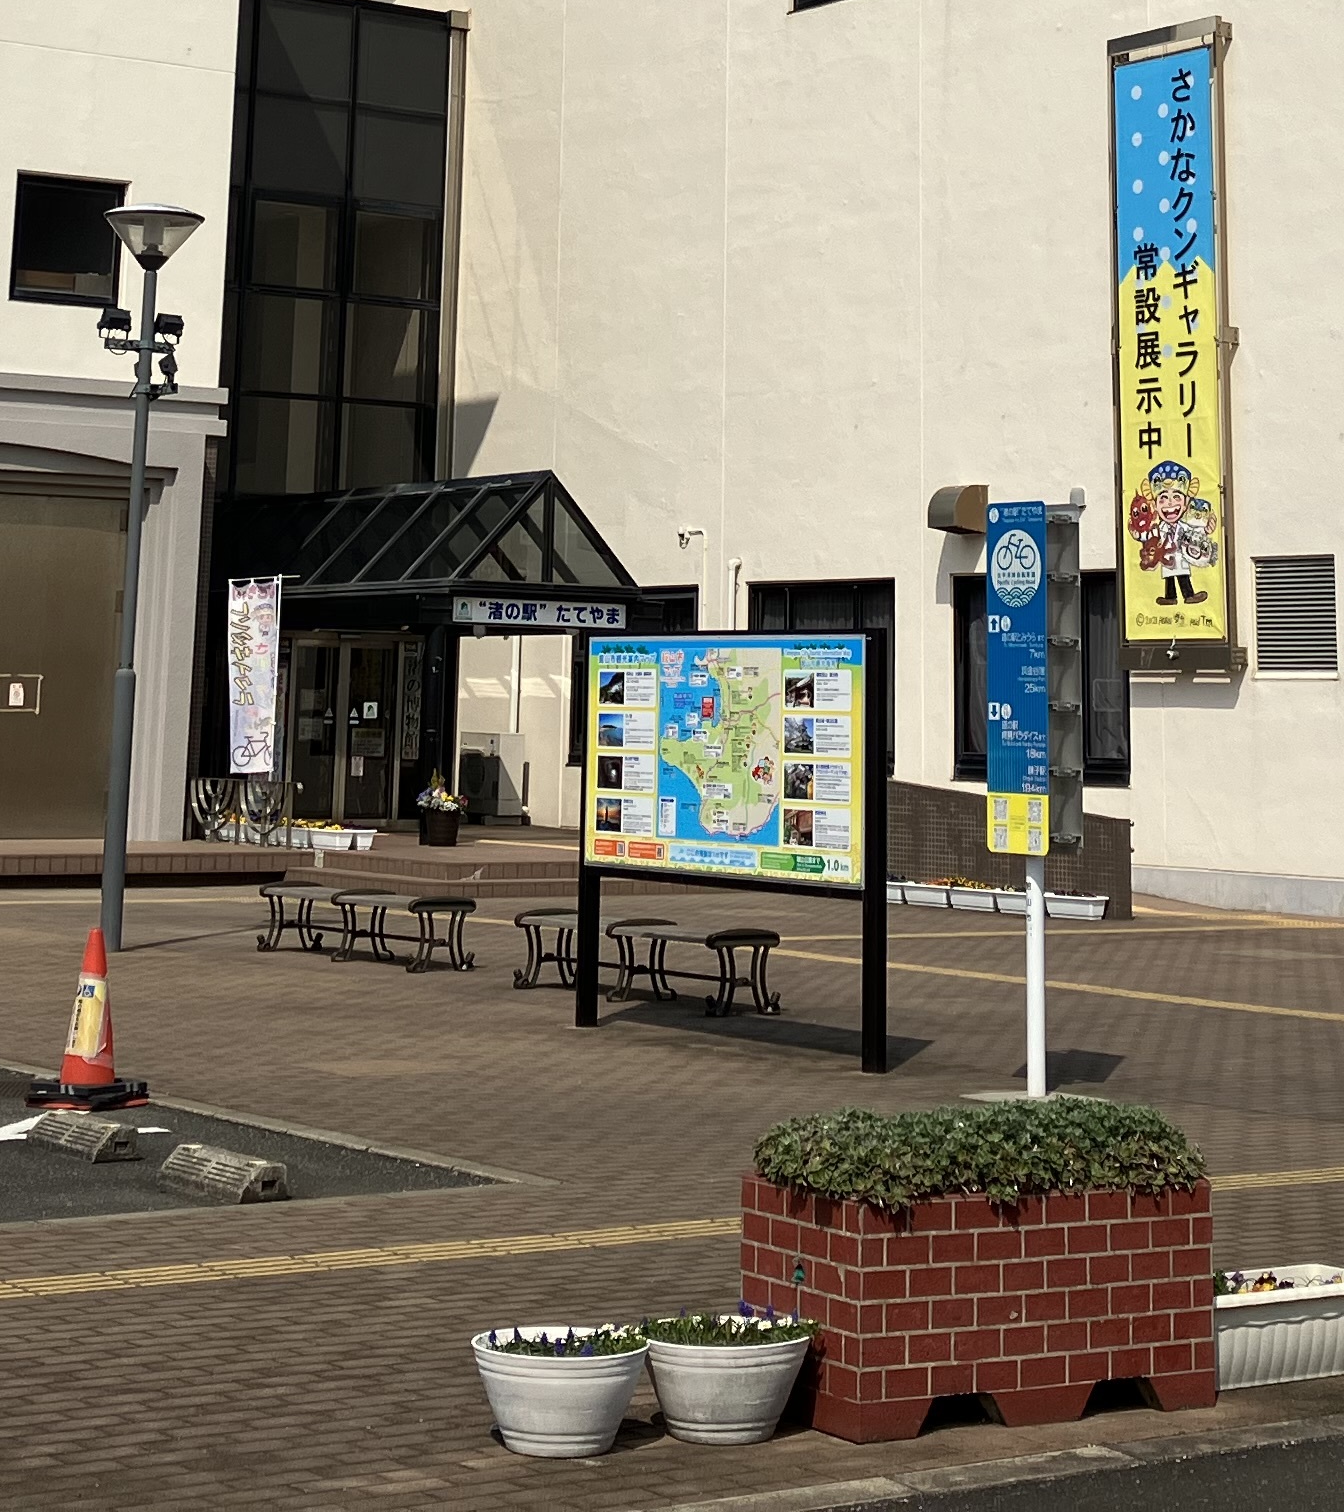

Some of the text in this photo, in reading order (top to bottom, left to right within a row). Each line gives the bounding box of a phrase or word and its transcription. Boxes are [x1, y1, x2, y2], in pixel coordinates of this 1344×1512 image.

[1133, 242, 1163, 460] 常設展示中
[1169, 68, 1199, 458] さかなクンギャラリー
[555, 604, 620, 624] たてやま
